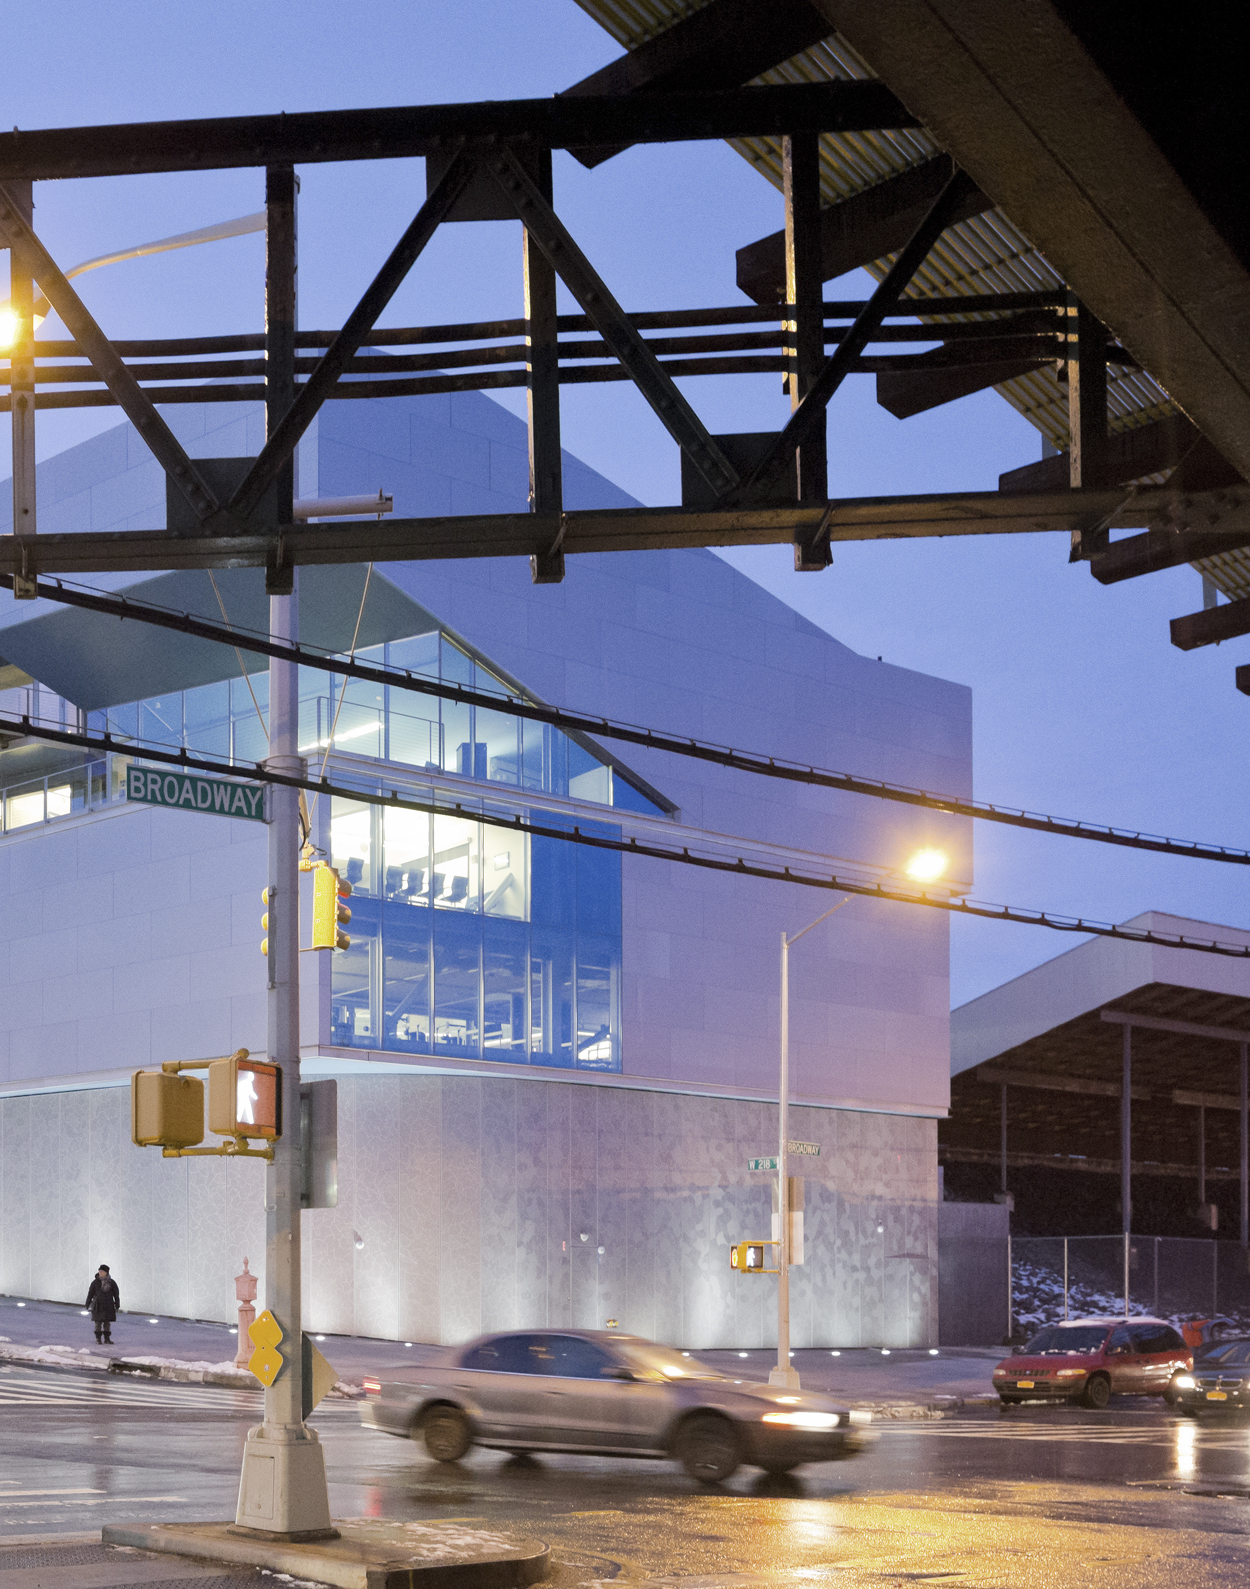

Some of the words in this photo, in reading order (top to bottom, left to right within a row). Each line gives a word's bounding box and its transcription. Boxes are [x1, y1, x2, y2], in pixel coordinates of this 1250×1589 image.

[130, 770, 262, 816] BROADWAY
[788, 1142, 819, 1155] BROADWAY
[749, 1160, 756, 1170] W
[758, 1159, 771, 1170] 218
